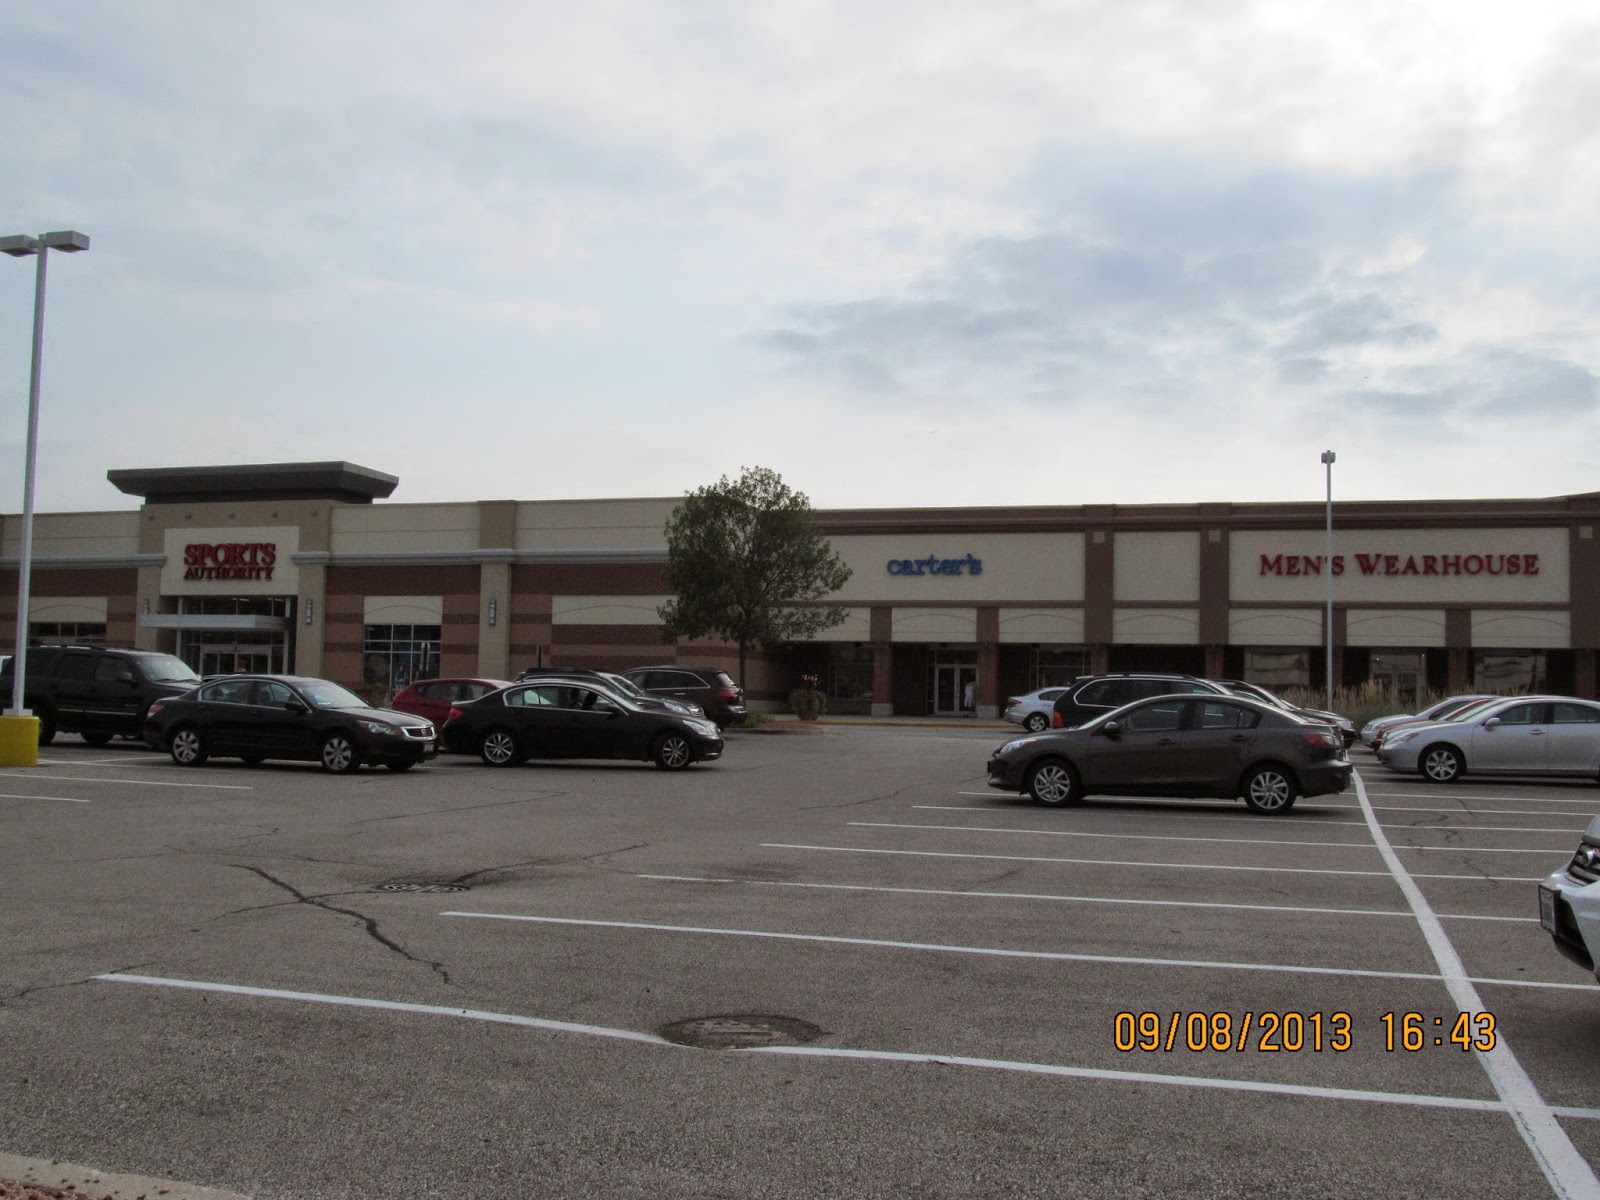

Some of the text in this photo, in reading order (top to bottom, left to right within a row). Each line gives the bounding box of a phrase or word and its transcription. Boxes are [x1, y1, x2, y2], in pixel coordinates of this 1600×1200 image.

[184, 543, 276, 566] SPORTS
[886, 553, 983, 576] carter's
[1259, 553, 1540, 576] MEN'S WEARHOUSE
[183, 566, 275, 580] AUTHORITY
